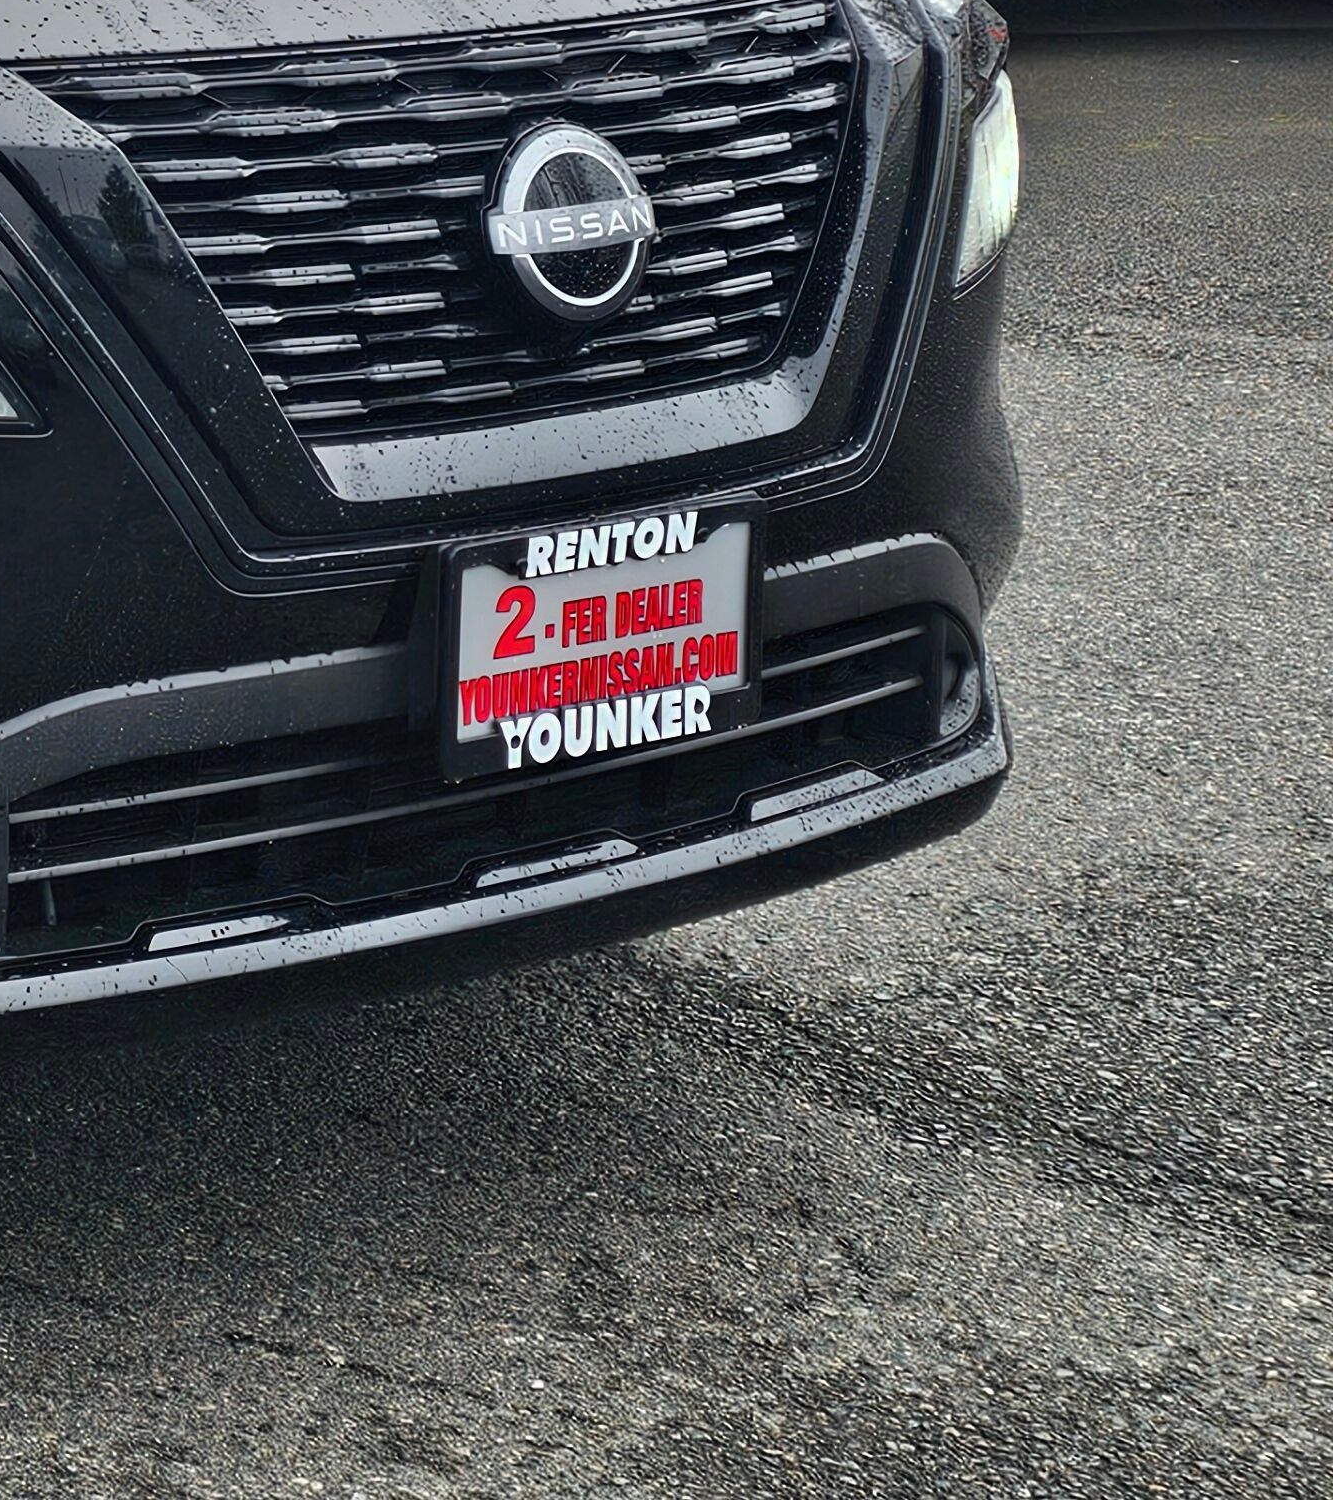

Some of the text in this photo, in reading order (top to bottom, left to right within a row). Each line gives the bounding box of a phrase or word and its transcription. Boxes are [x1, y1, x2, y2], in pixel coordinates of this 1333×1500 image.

[497, 204, 652, 249] NISSAN
[525, 510, 699, 578] RENTON
[615, 579, 704, 637] DEALER
[459, 631, 738, 726] YOUNKERNISSAN.COM
[500, 684, 712, 769] YOUNKER
